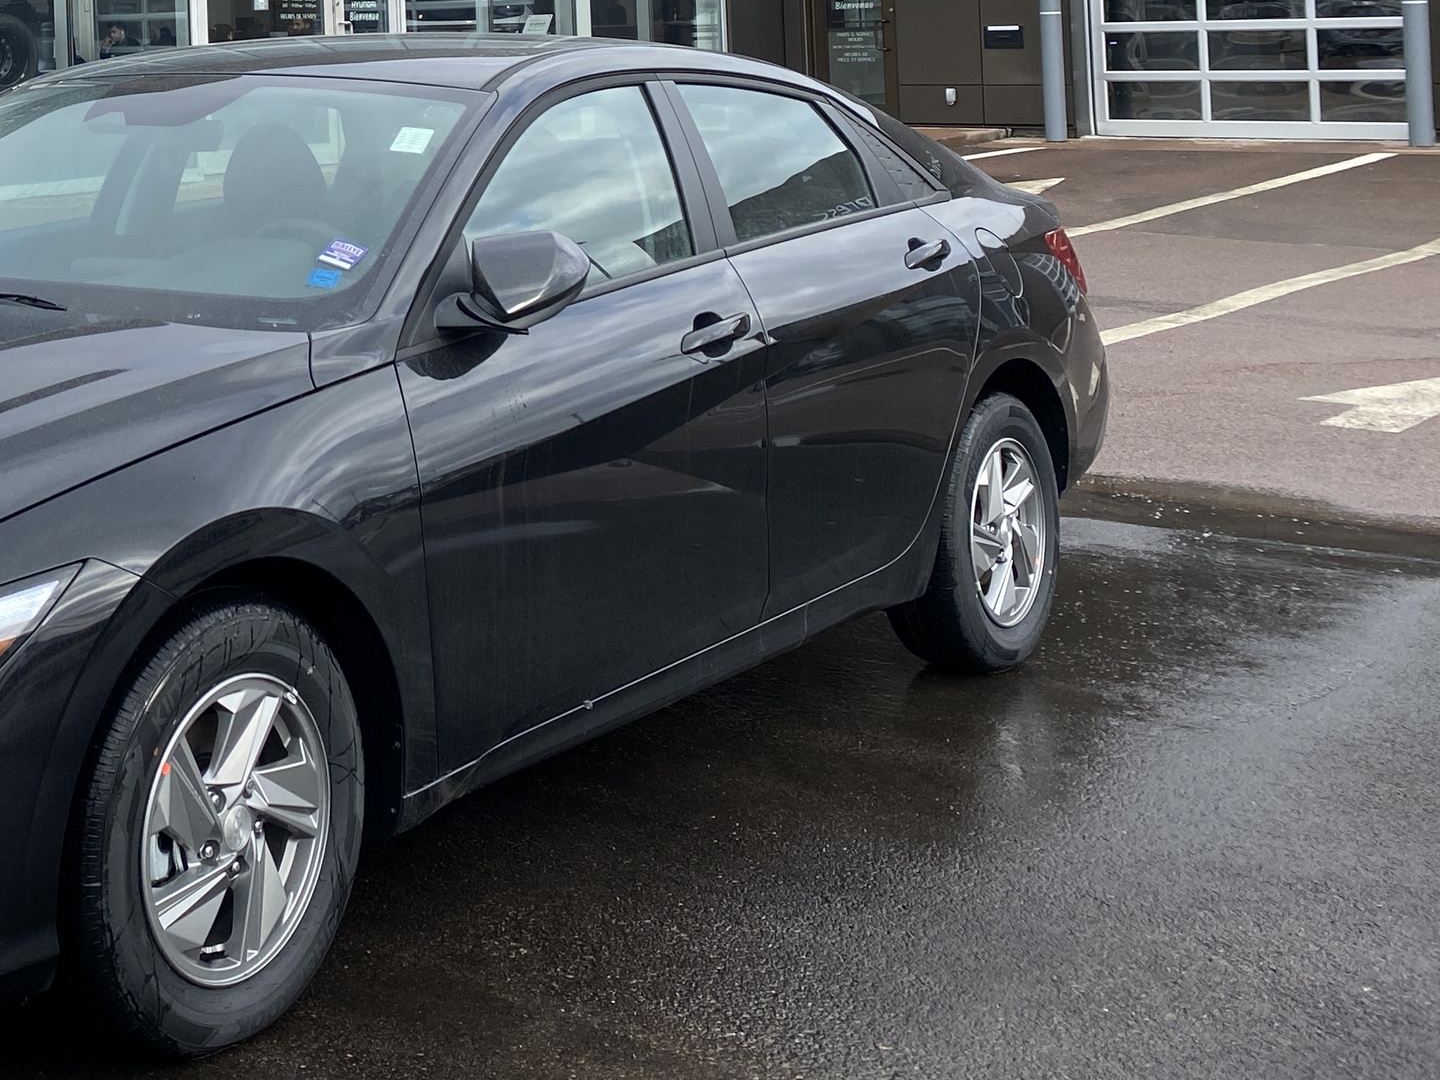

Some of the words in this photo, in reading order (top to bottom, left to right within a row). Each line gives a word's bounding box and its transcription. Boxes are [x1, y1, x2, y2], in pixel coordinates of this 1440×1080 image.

[835, 2, 874, 10] Bienvenue
[349, 11, 380, 21] Bienvenue
[333, 242, 363, 256] RALLYE
